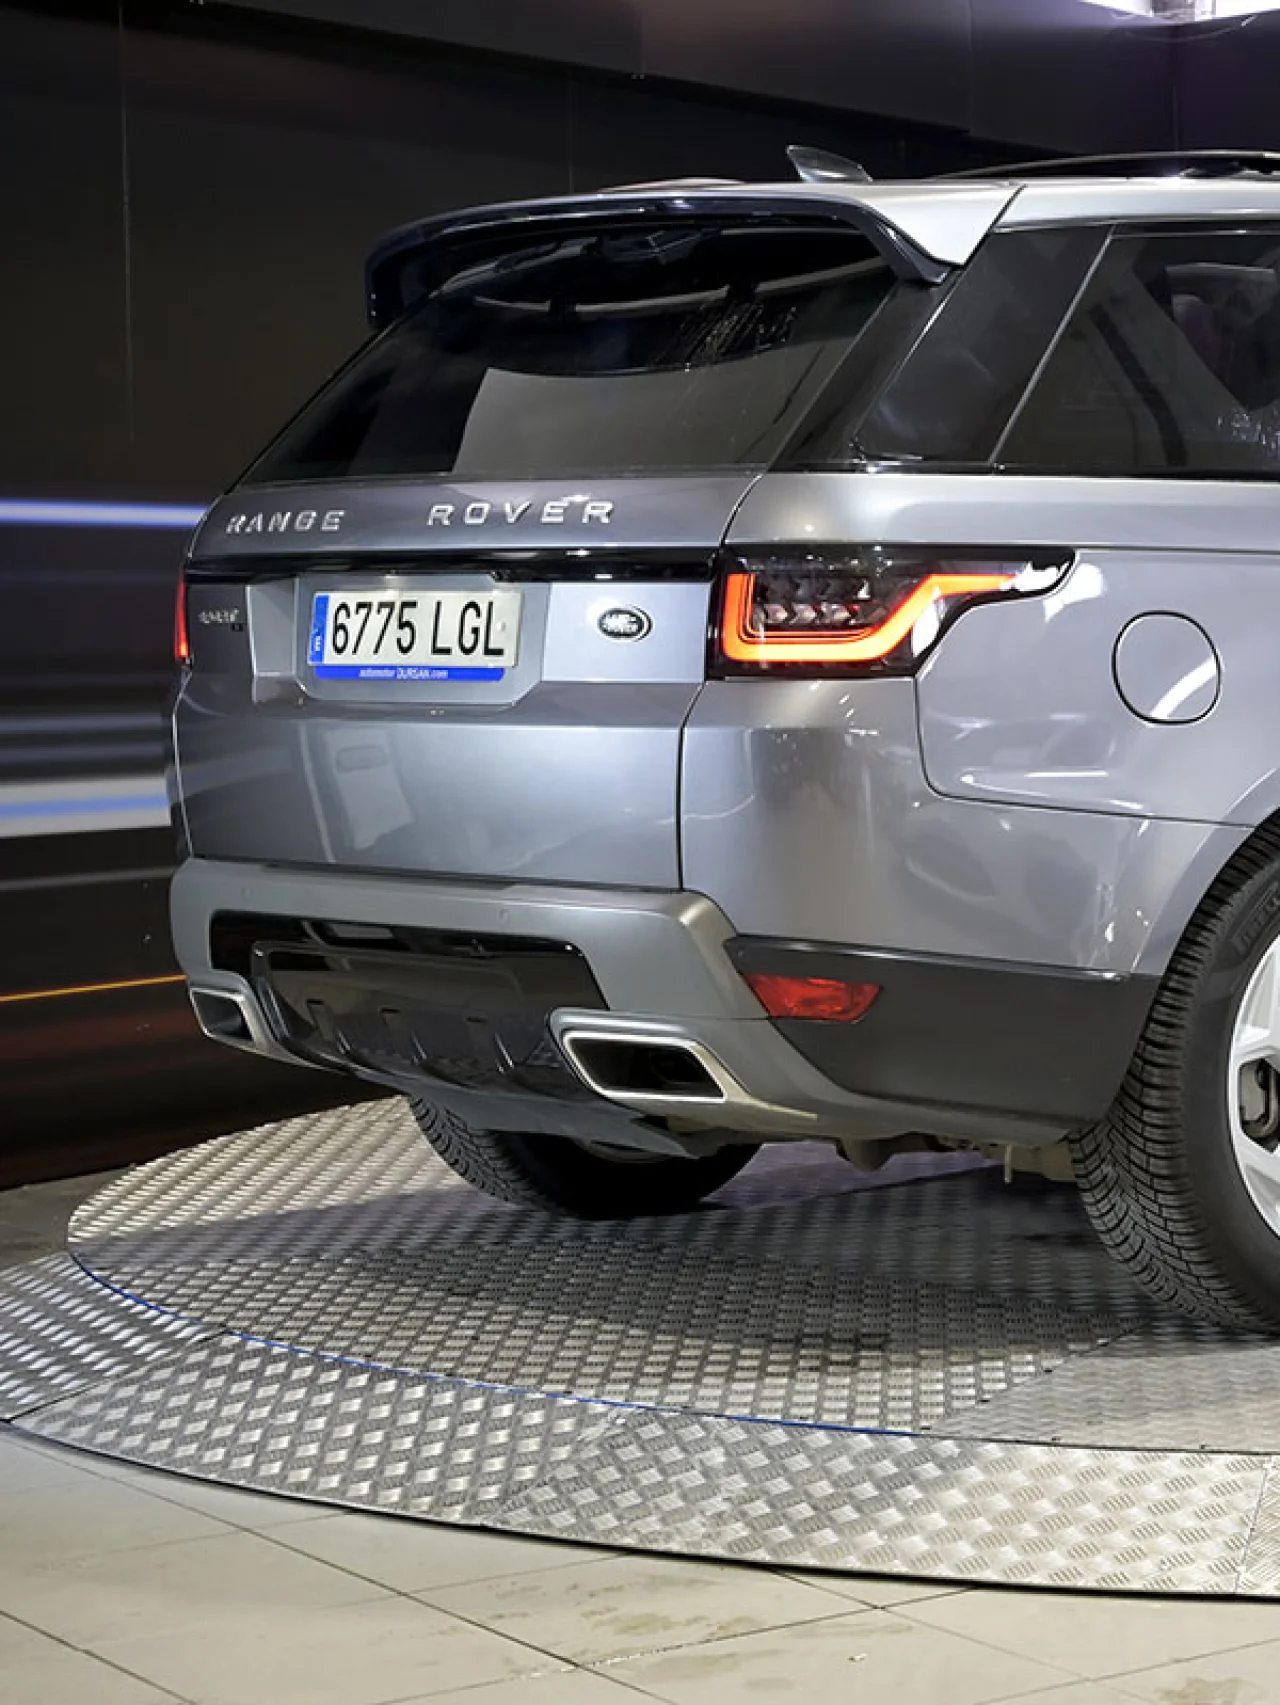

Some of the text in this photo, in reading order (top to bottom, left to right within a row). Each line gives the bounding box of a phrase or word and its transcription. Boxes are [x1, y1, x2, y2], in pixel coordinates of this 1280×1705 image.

[225, 500, 614, 534] RANGE ROVER
[332, 600, 505, 656] 6775 LGL
